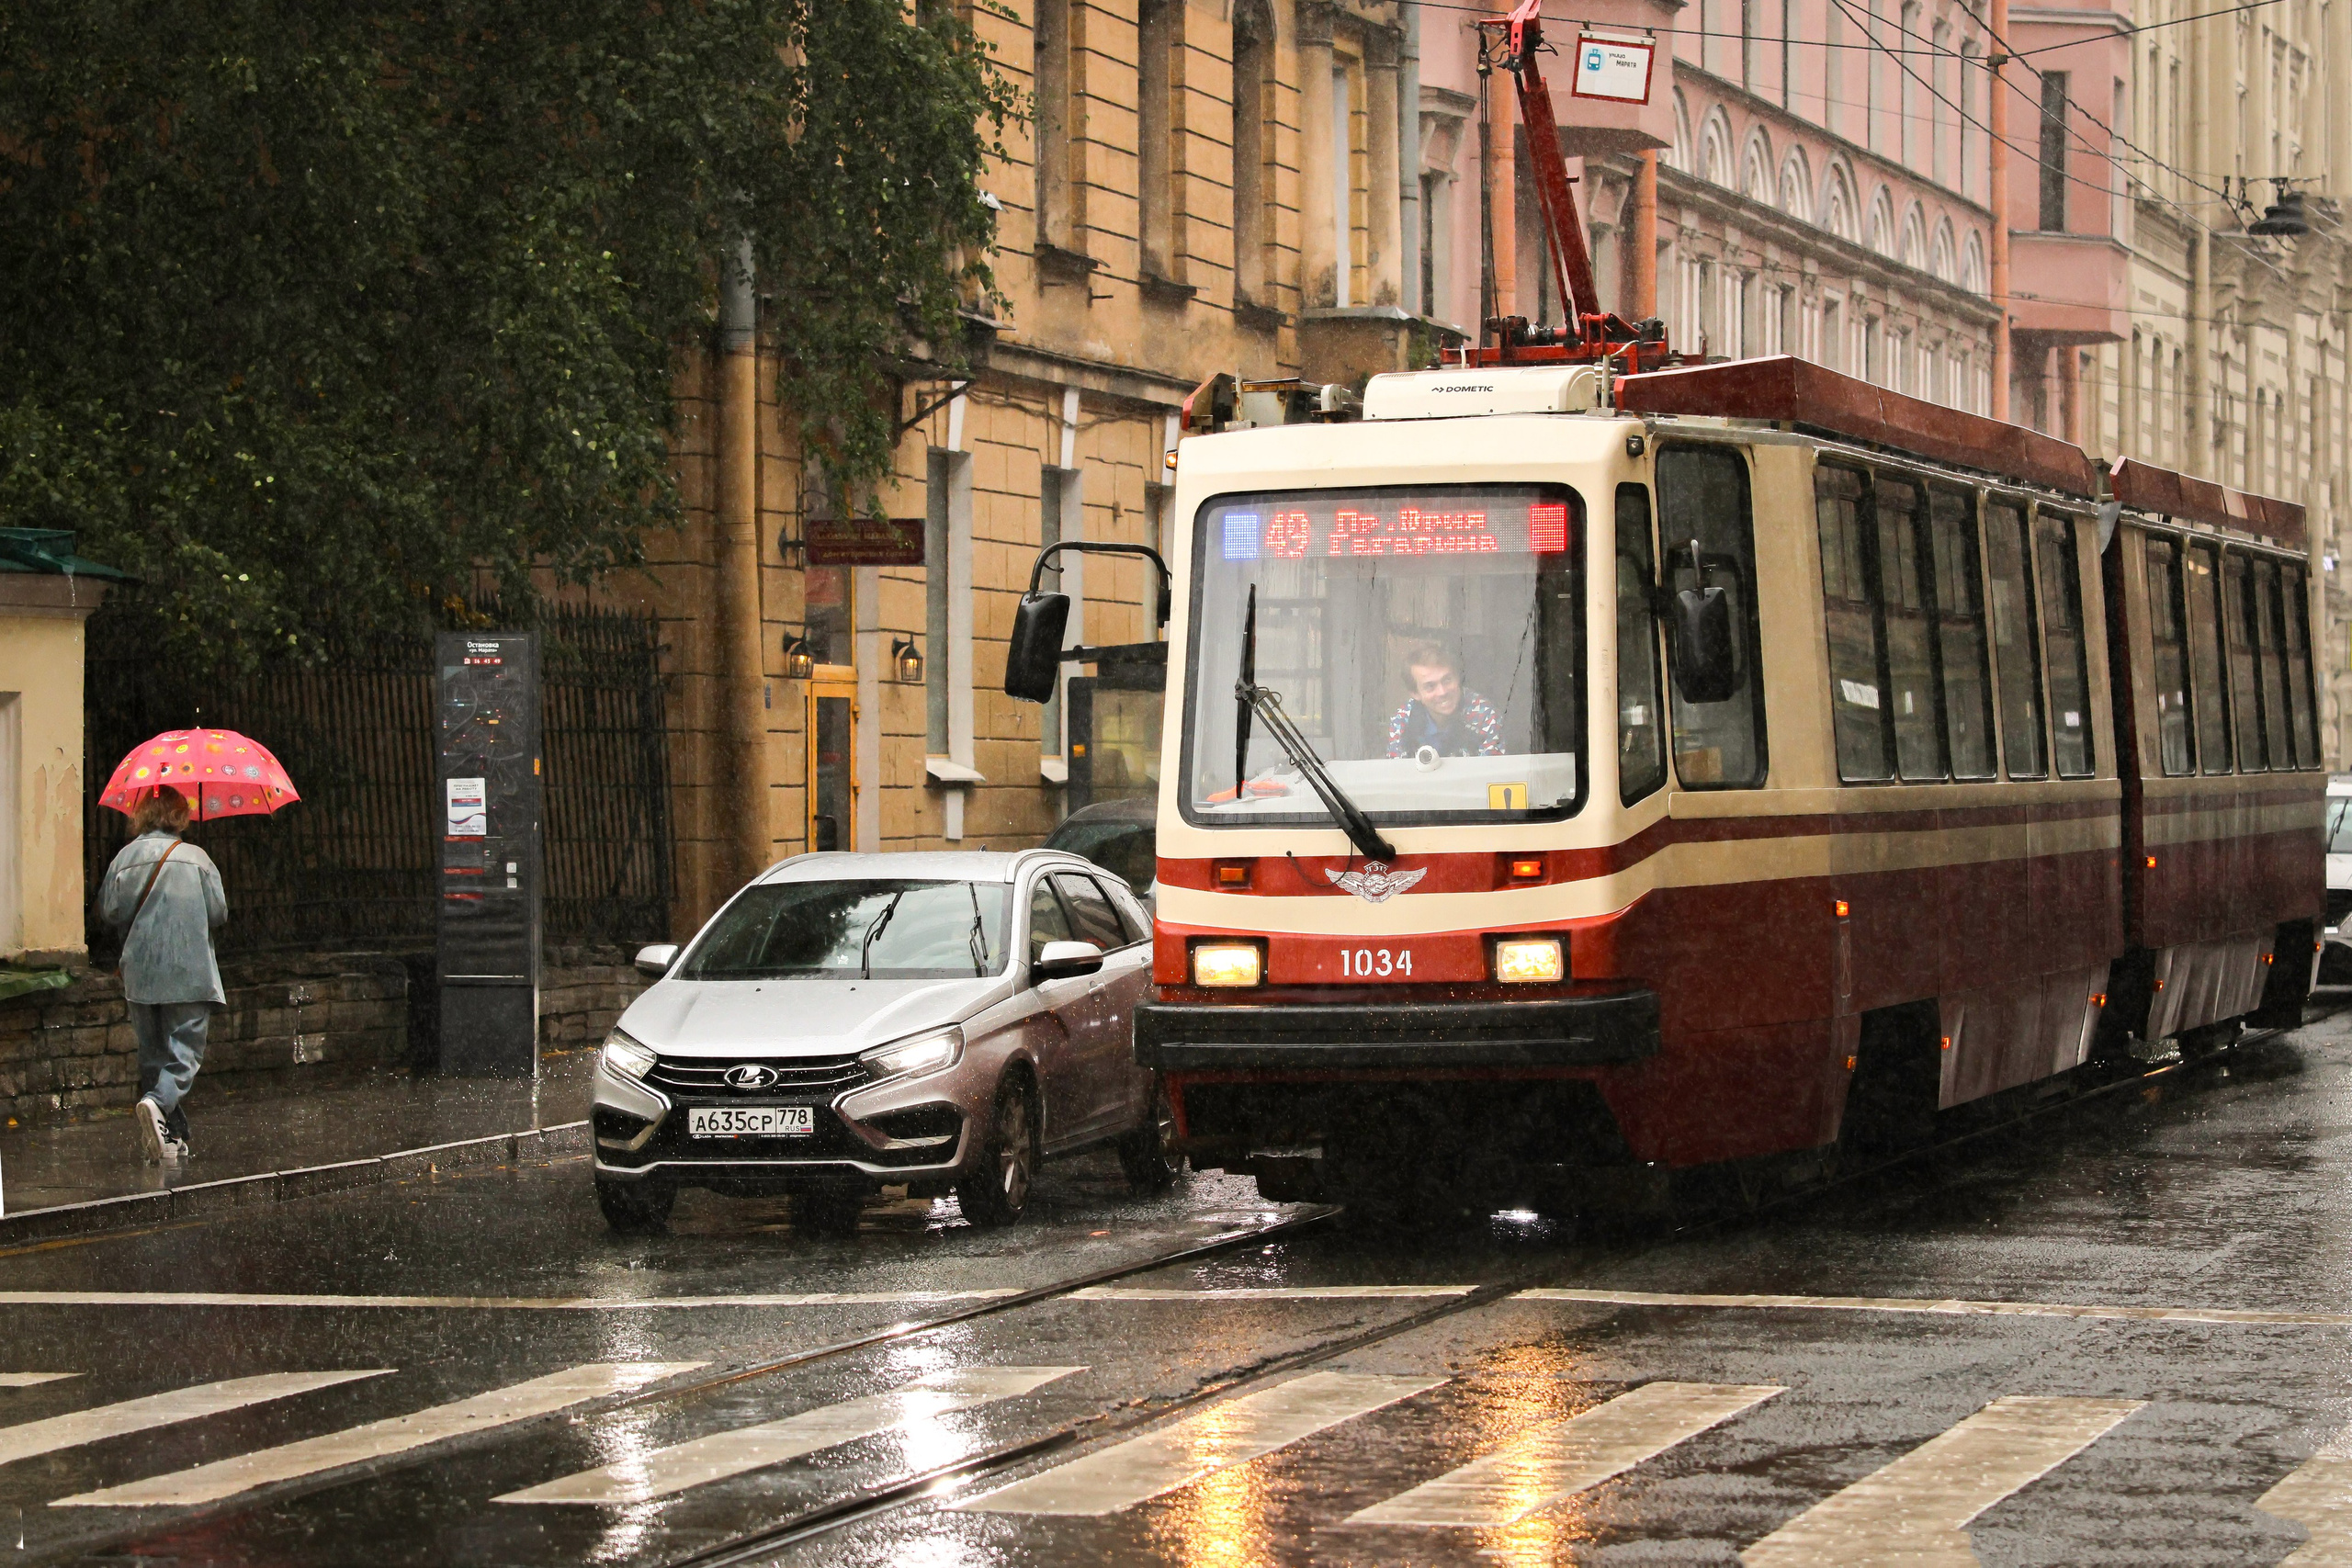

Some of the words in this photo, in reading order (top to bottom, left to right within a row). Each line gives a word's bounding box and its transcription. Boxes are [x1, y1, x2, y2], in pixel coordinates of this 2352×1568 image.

[1265, 511, 1310, 558] 49
[1328, 533, 1499, 557] Гагарина
[1340, 949, 1413, 976] 1034
[777, 1109, 808, 1125] 778
